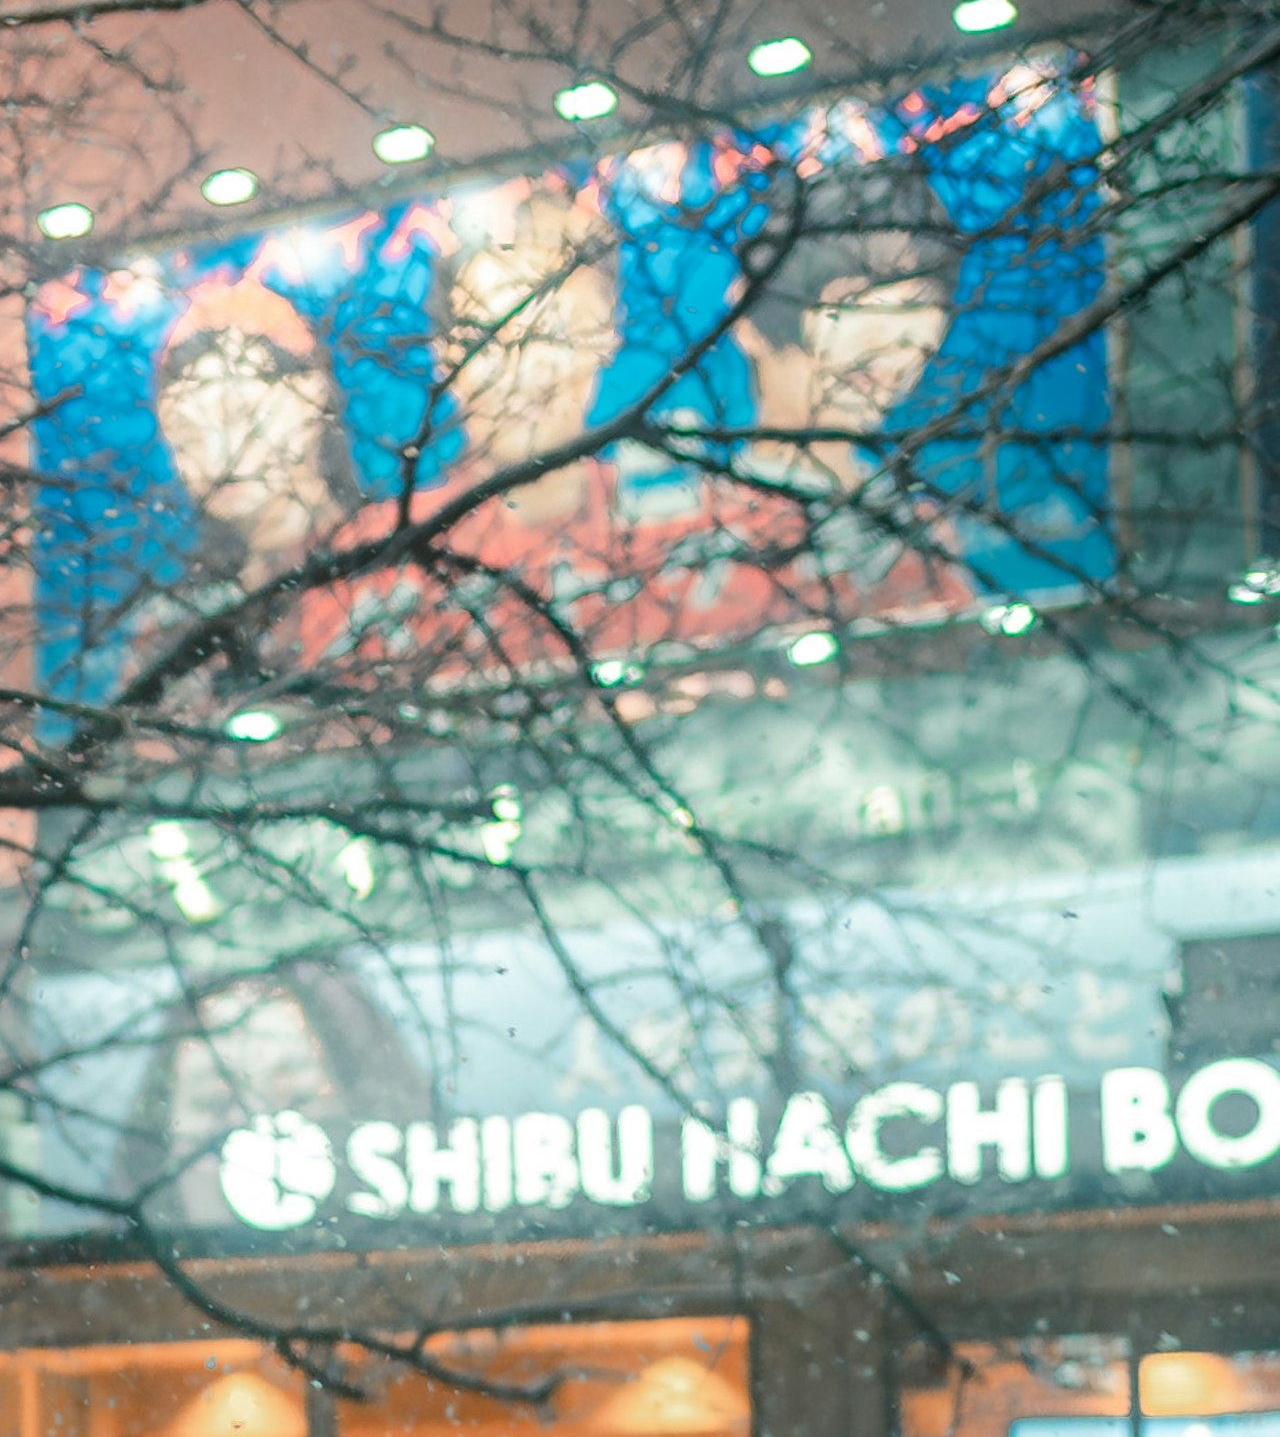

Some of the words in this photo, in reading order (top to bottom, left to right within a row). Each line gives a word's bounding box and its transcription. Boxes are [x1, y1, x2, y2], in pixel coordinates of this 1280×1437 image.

[345, 1105, 654, 1220] SHIBU
[682, 1075, 1069, 1199] HACHI
[1101, 1057, 1280, 1175] BO
